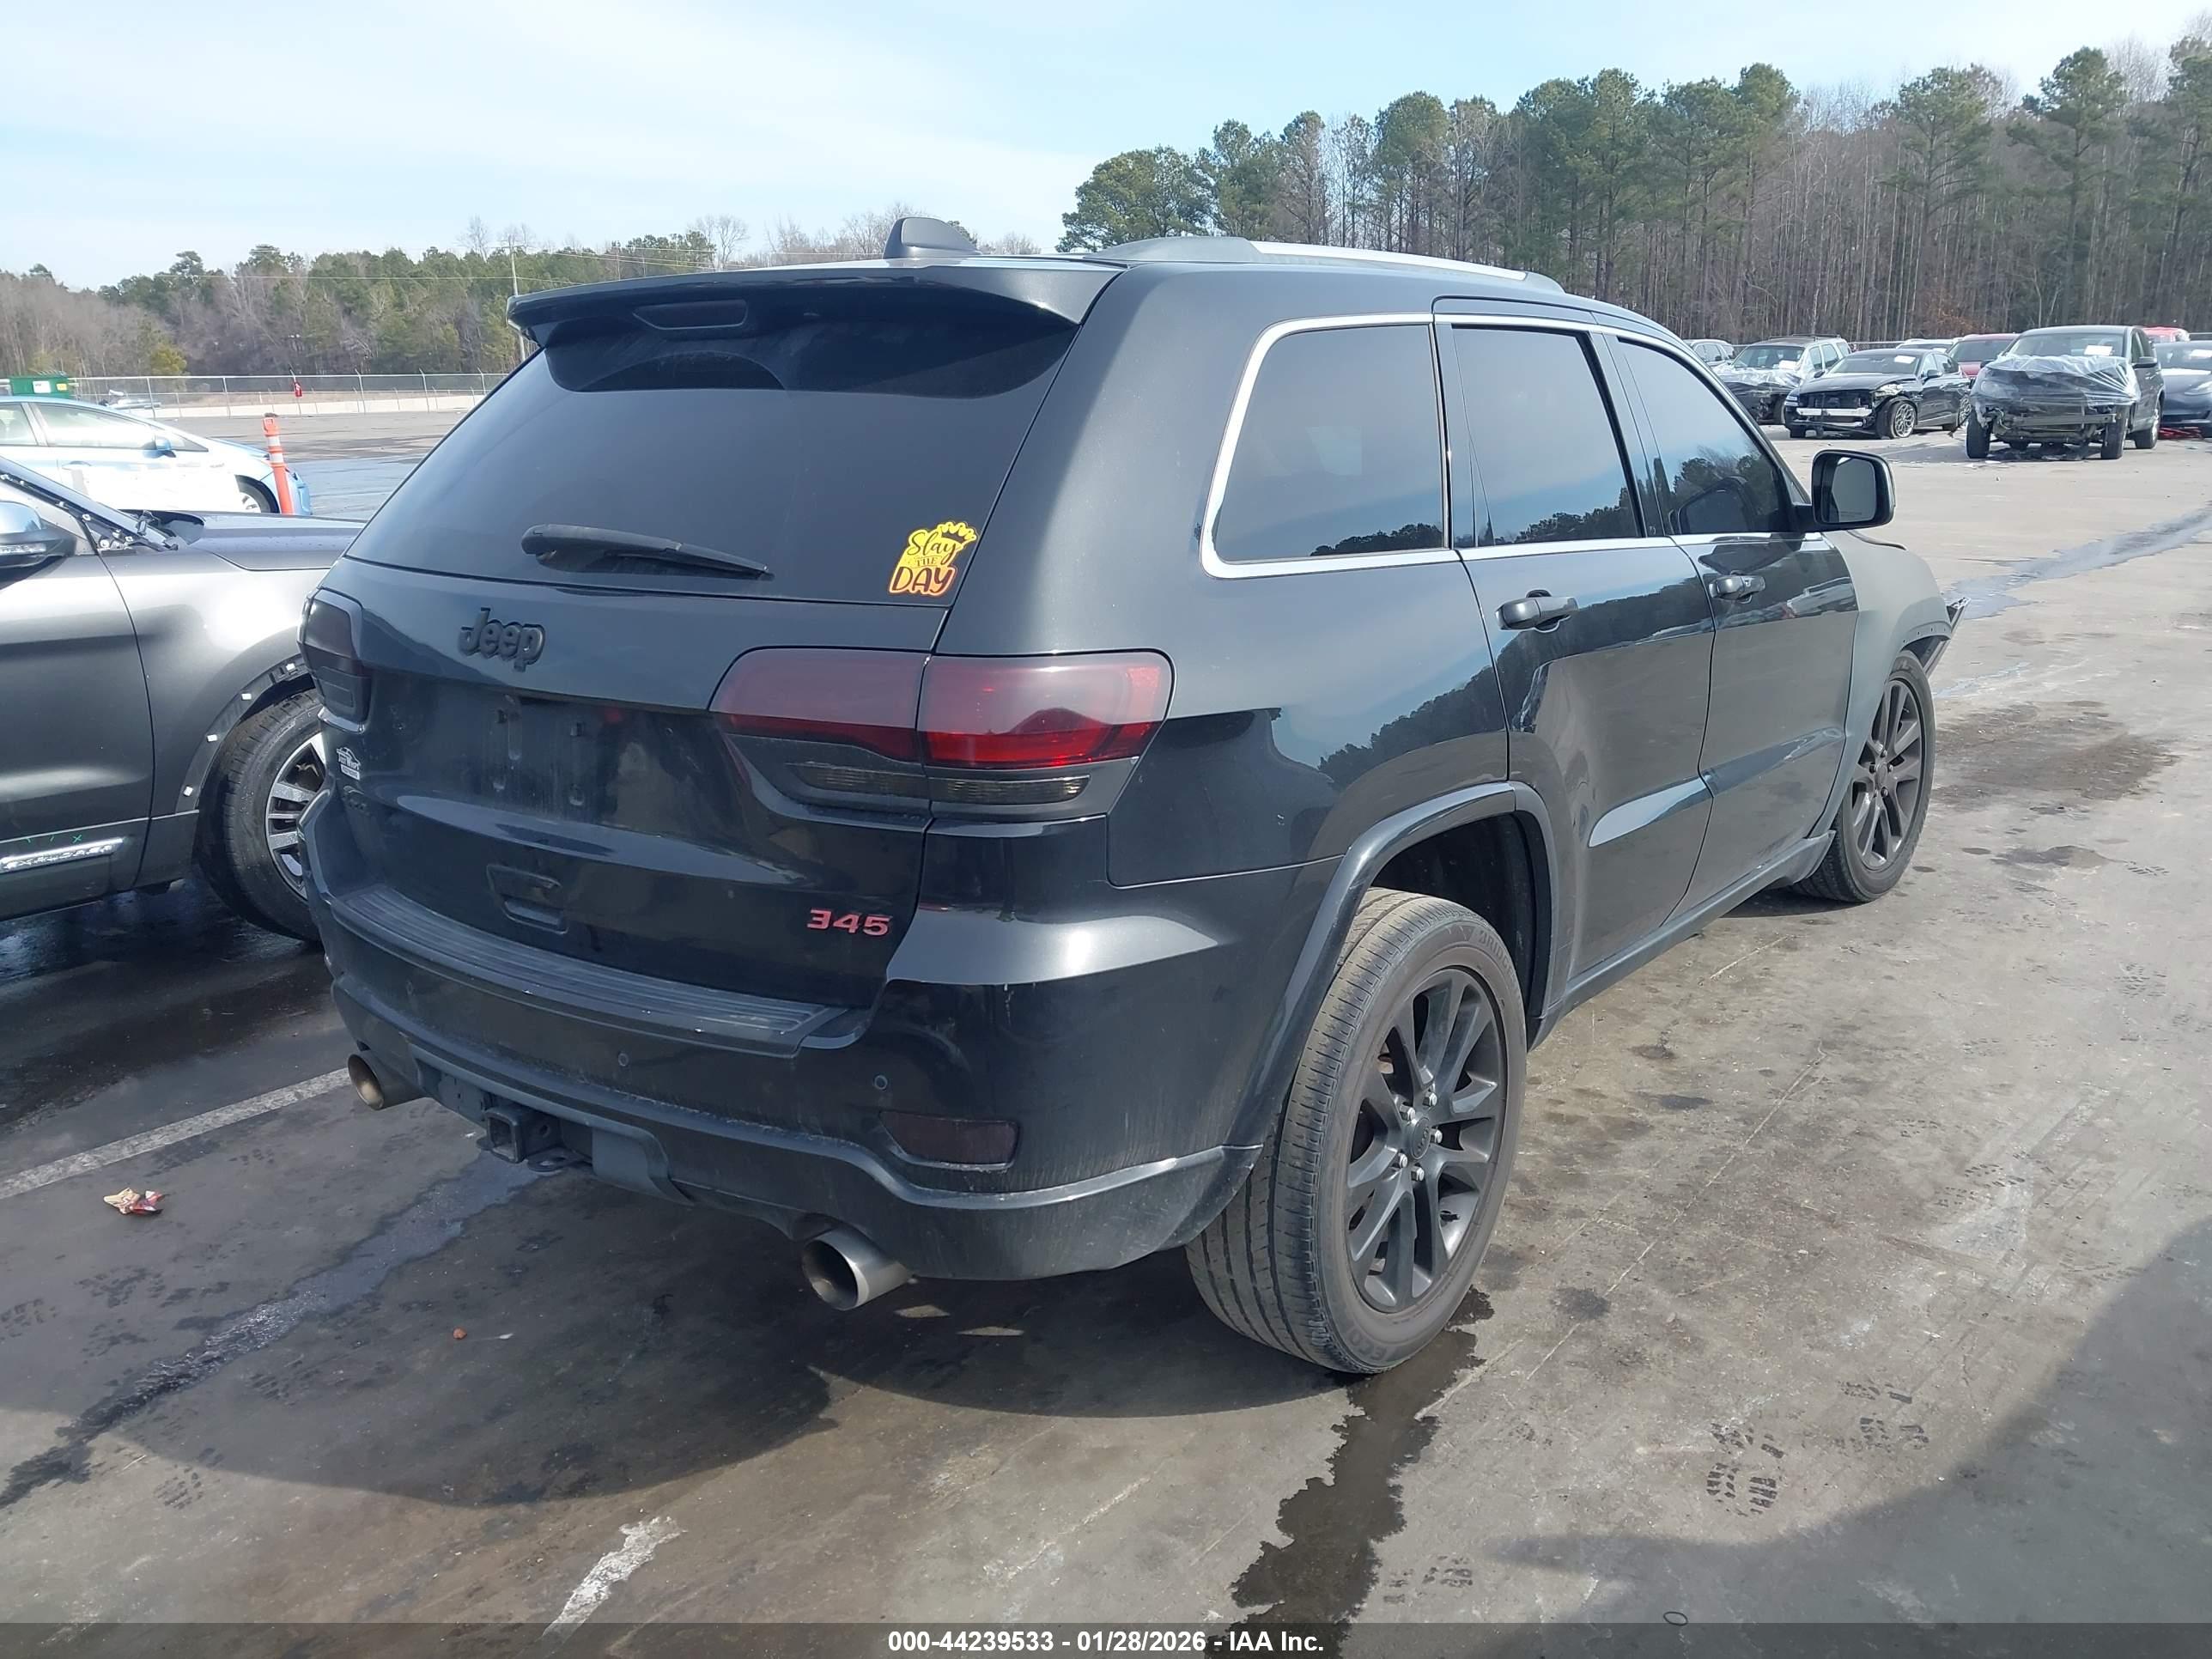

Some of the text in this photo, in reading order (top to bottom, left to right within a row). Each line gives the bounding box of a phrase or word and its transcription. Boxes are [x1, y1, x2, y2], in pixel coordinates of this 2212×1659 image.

[907, 532, 957, 564] Slay
[916, 556, 938, 567] THE
[891, 566, 953, 592] DAY
[458, 606, 545, 672] Jeep
[807, 908, 892, 936] 345
